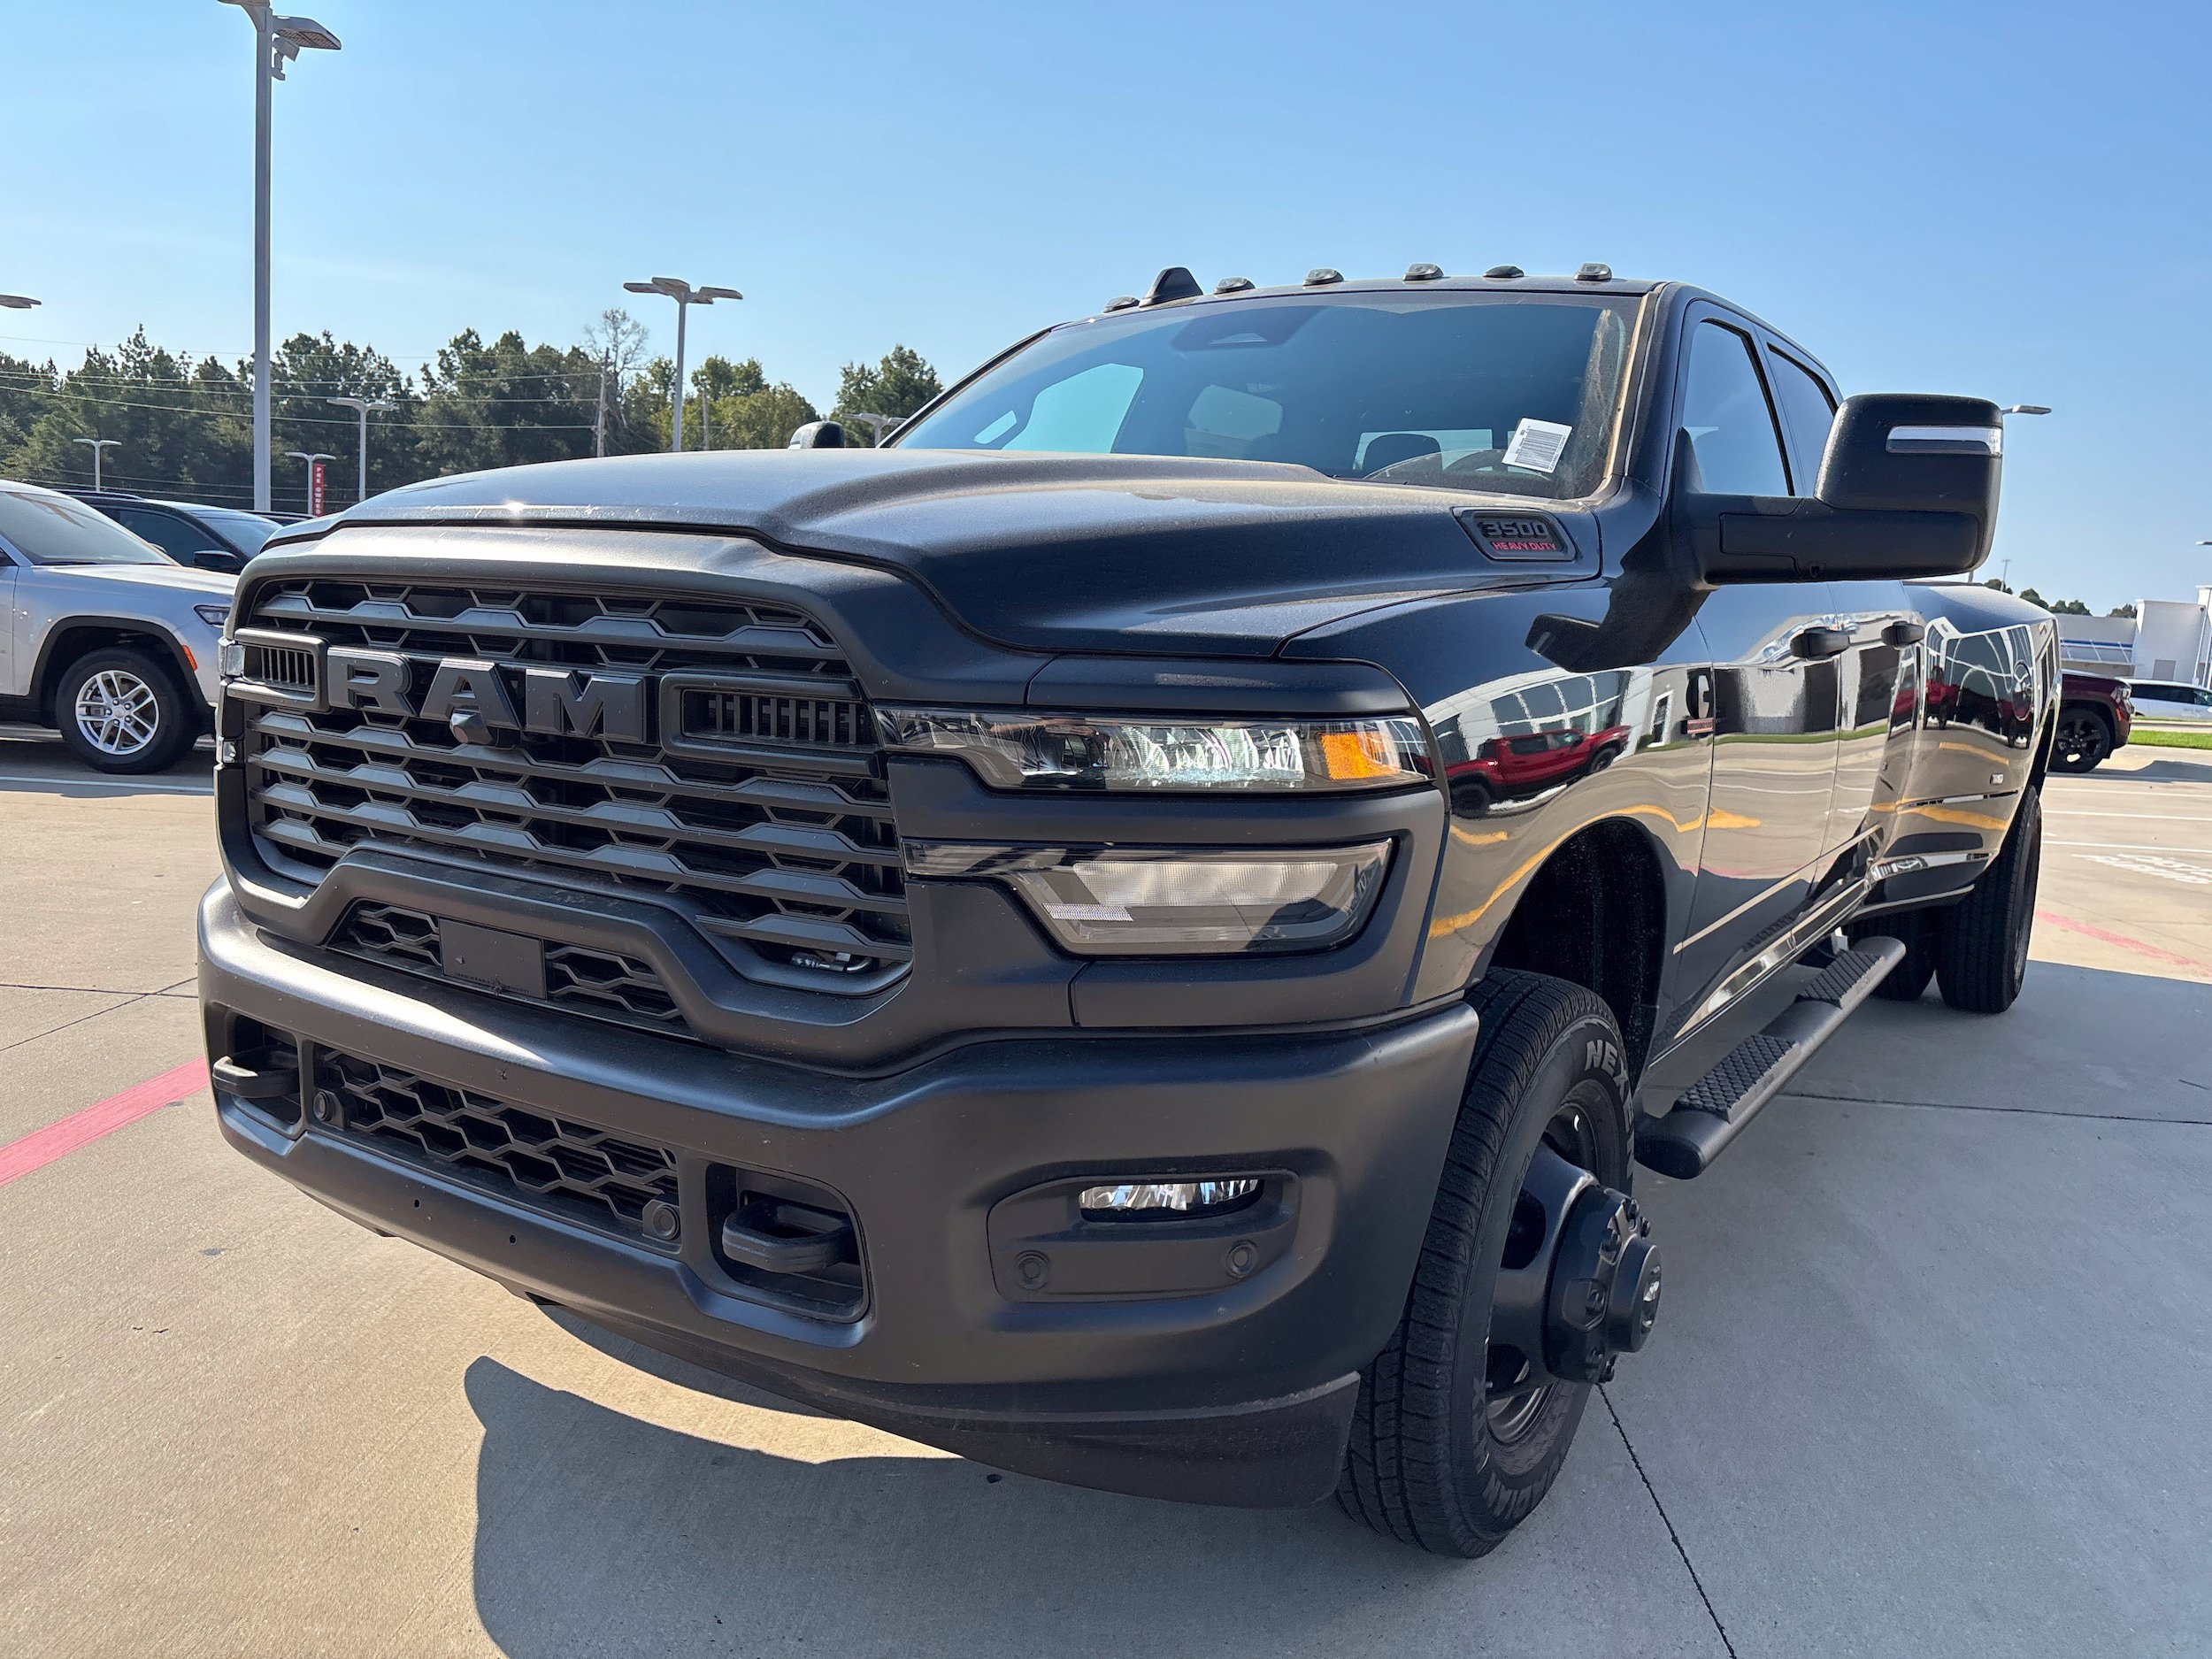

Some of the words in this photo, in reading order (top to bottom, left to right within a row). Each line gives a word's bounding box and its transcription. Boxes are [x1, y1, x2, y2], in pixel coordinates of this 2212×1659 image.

[1479, 520, 1548, 538] 3500
[1492, 541, 1528, 550] HEAVY
[326, 645, 649, 745] RAM
